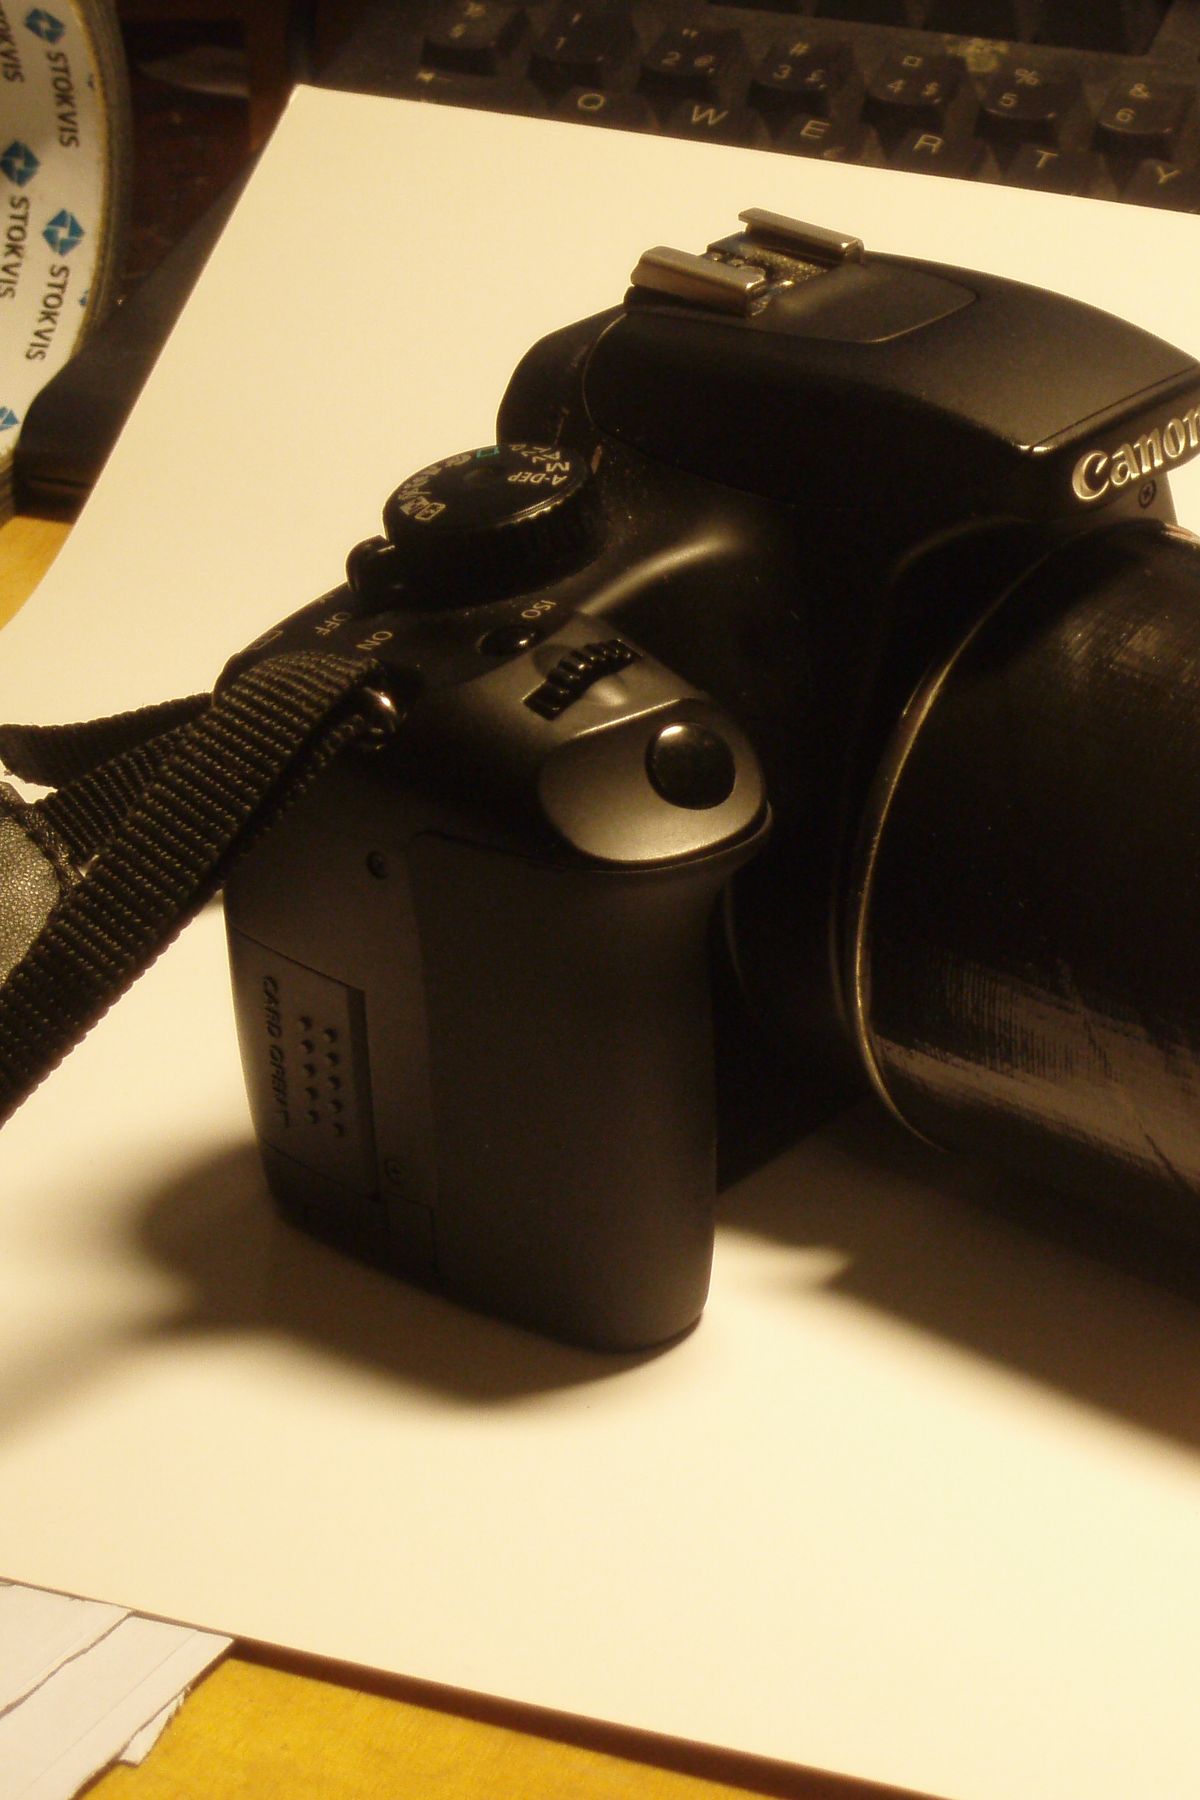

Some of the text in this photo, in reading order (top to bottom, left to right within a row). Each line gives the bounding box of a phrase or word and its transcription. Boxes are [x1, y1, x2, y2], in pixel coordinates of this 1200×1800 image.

[46, 51, 79, 148] STOKVIS
[690, 104, 729, 126] W
[800, 119, 831, 140] E
[912, 134, 945, 155] R
[1035, 148, 1059, 169] T
[1154, 163, 1183, 185] Y
[24, 264, 70, 362] STOKVIS
[507, 471, 569, 486] A-DEP
[355, 630, 394, 651] ON
[263, 975, 281, 1038] CARD
